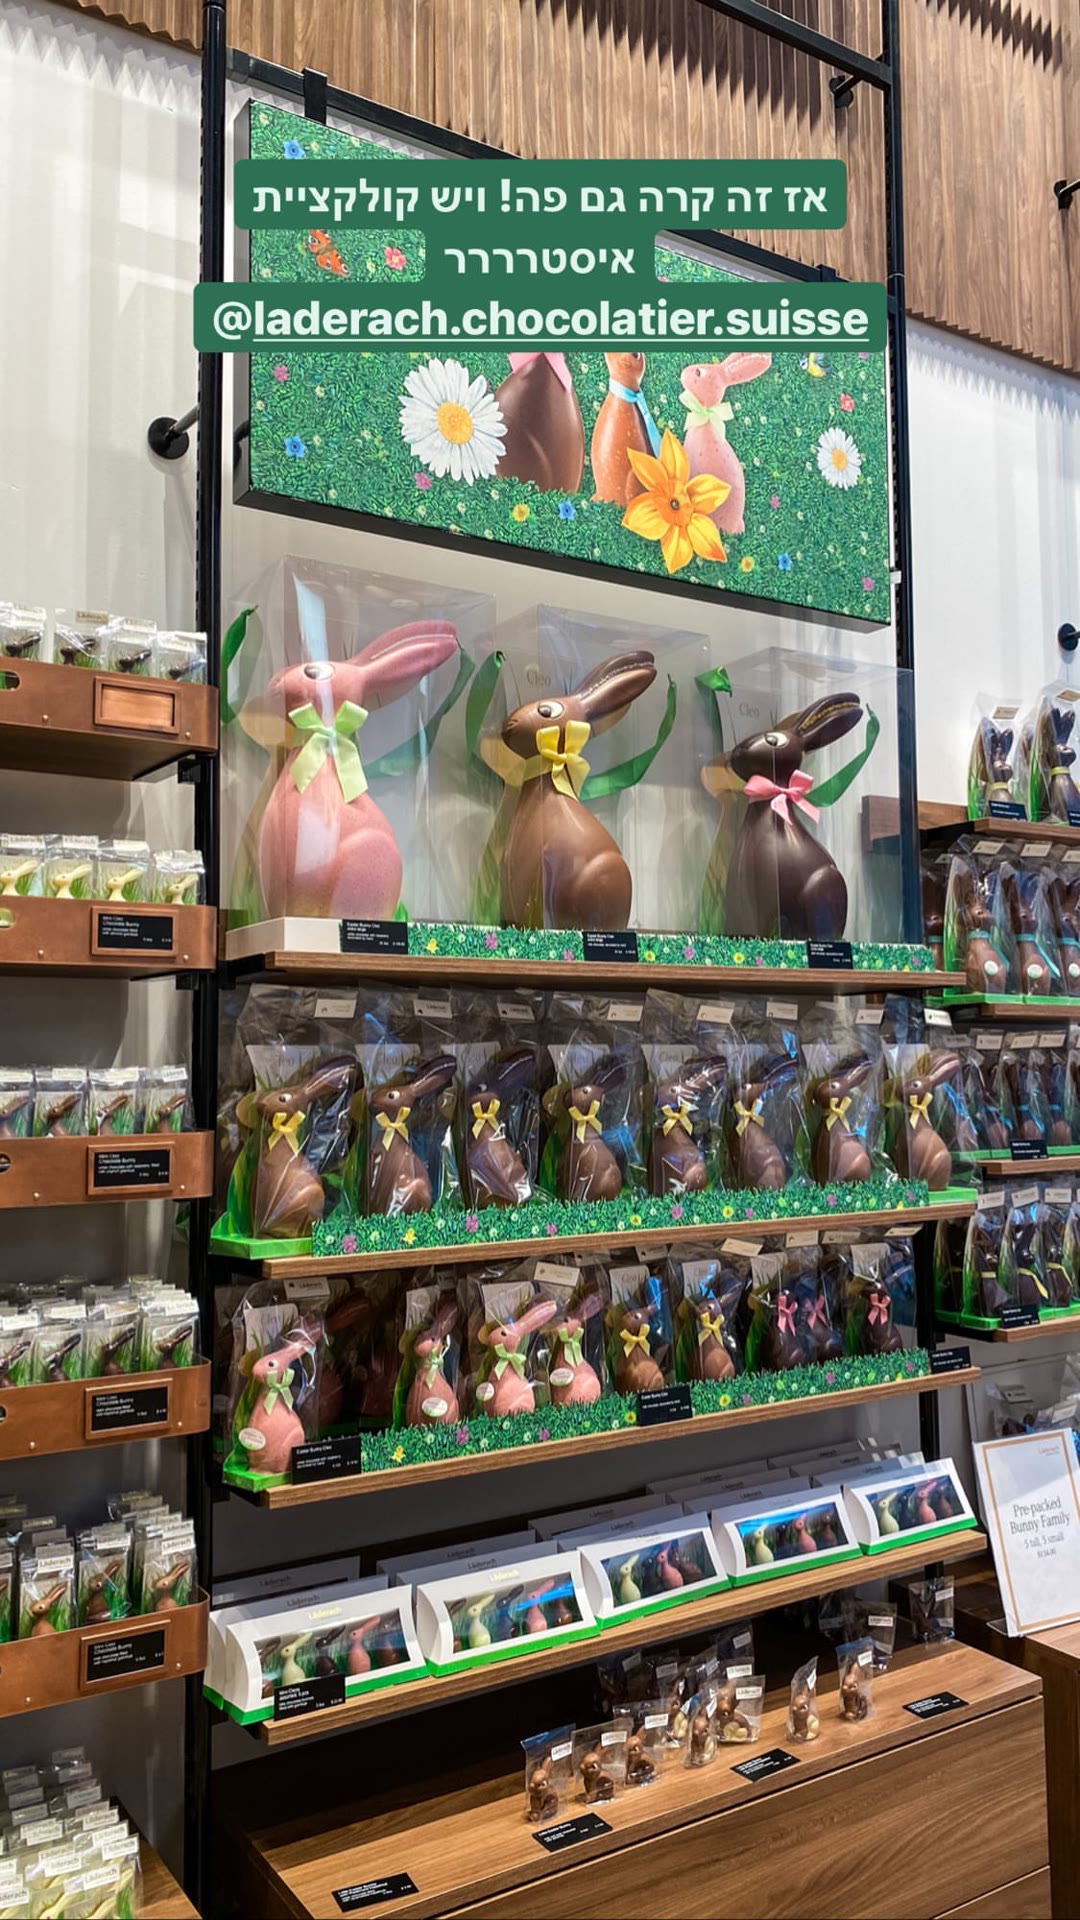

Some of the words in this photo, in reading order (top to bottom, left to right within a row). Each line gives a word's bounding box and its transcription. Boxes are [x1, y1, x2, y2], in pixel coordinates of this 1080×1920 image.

[526, 669, 551, 688] Cleo
[739, 703, 760, 718] Cleo
[1013, 1496, 1061, 1517] Pre-packed
[1009, 1519, 1039, 1534] Bunny
[1040, 1511, 1070, 1528] Family
[1024, 1540, 1030, 1549] 5
[1048, 1531, 1064, 1543] small
